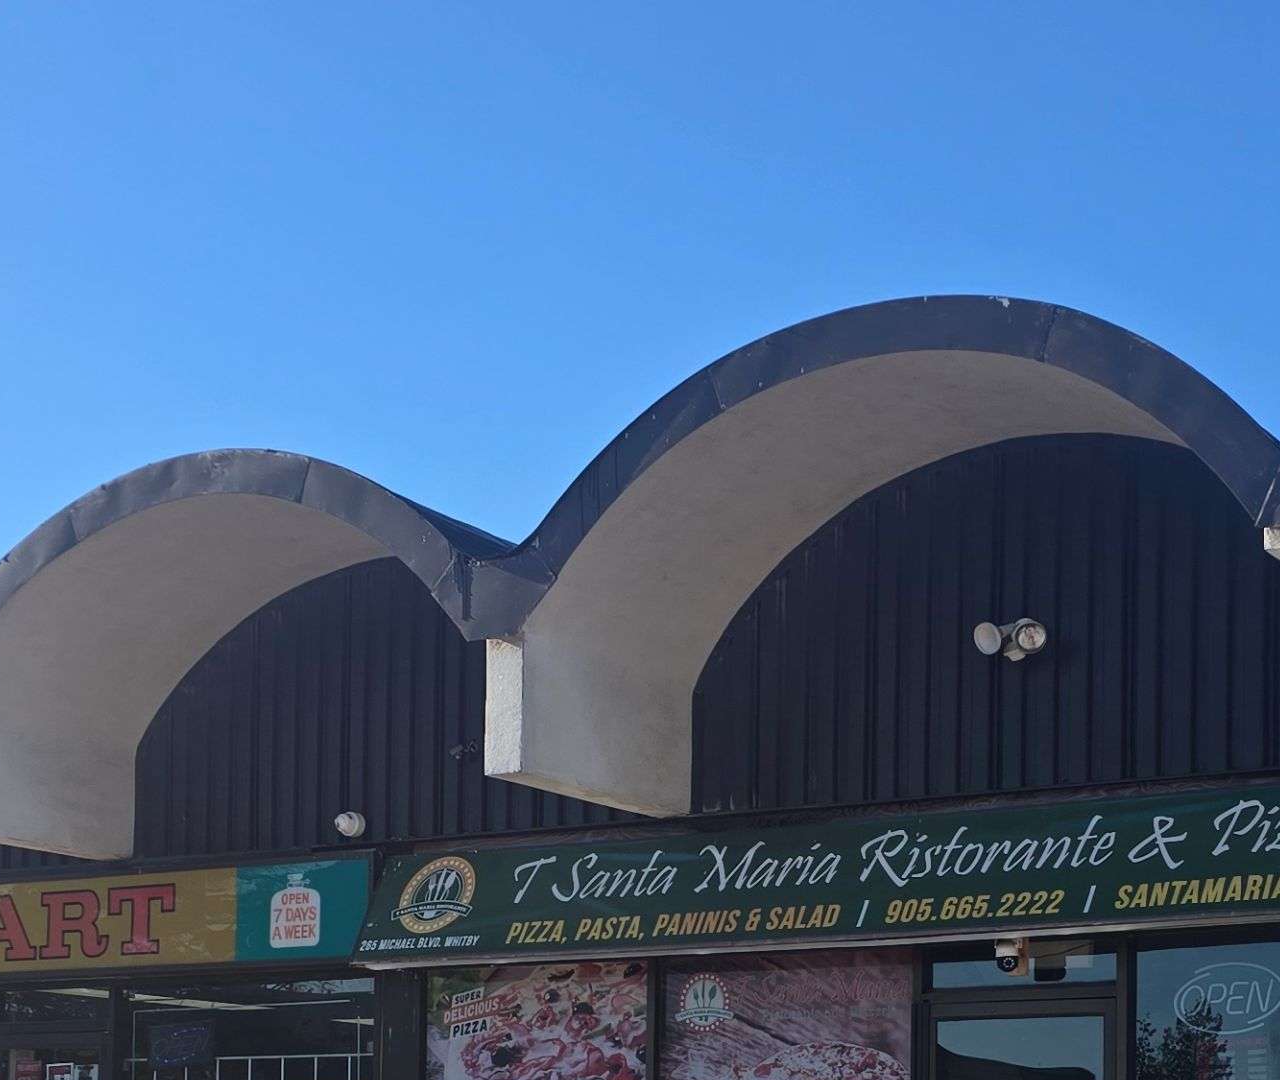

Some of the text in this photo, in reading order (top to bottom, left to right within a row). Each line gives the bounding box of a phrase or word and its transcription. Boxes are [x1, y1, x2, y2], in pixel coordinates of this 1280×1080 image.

[513, 856, 558, 905] T
[551, 850, 678, 902] Santa
[693, 840, 842, 893] Maria
[858, 814, 1117, 888] Ristorante
[1128, 815, 1188, 870] &
[281, 892, 310, 906] OPEN
[273, 907, 317, 923] 7 DAYS
[505, 919, 568, 945] PIZZA,
[574, 915, 645, 942] PASTA,
[652, 906, 738, 938] PANINIS
[744, 908, 761, 932] &
[765, 903, 842, 931] SALAD
[884, 889, 1065, 925] 905.665.2222
[272, 923, 317, 941] A WEEK
[378, 938, 416, 950] MICHAEL
[417, 937, 441, 949] BLVD.
[444, 935, 480, 947] WHITBY
[454, 990, 481, 1005] SUPER
[1180, 978, 1274, 1017] OPEN
[443, 1000, 500, 1024] DELICIOUS
[452, 1019, 488, 1038] PIZZA
